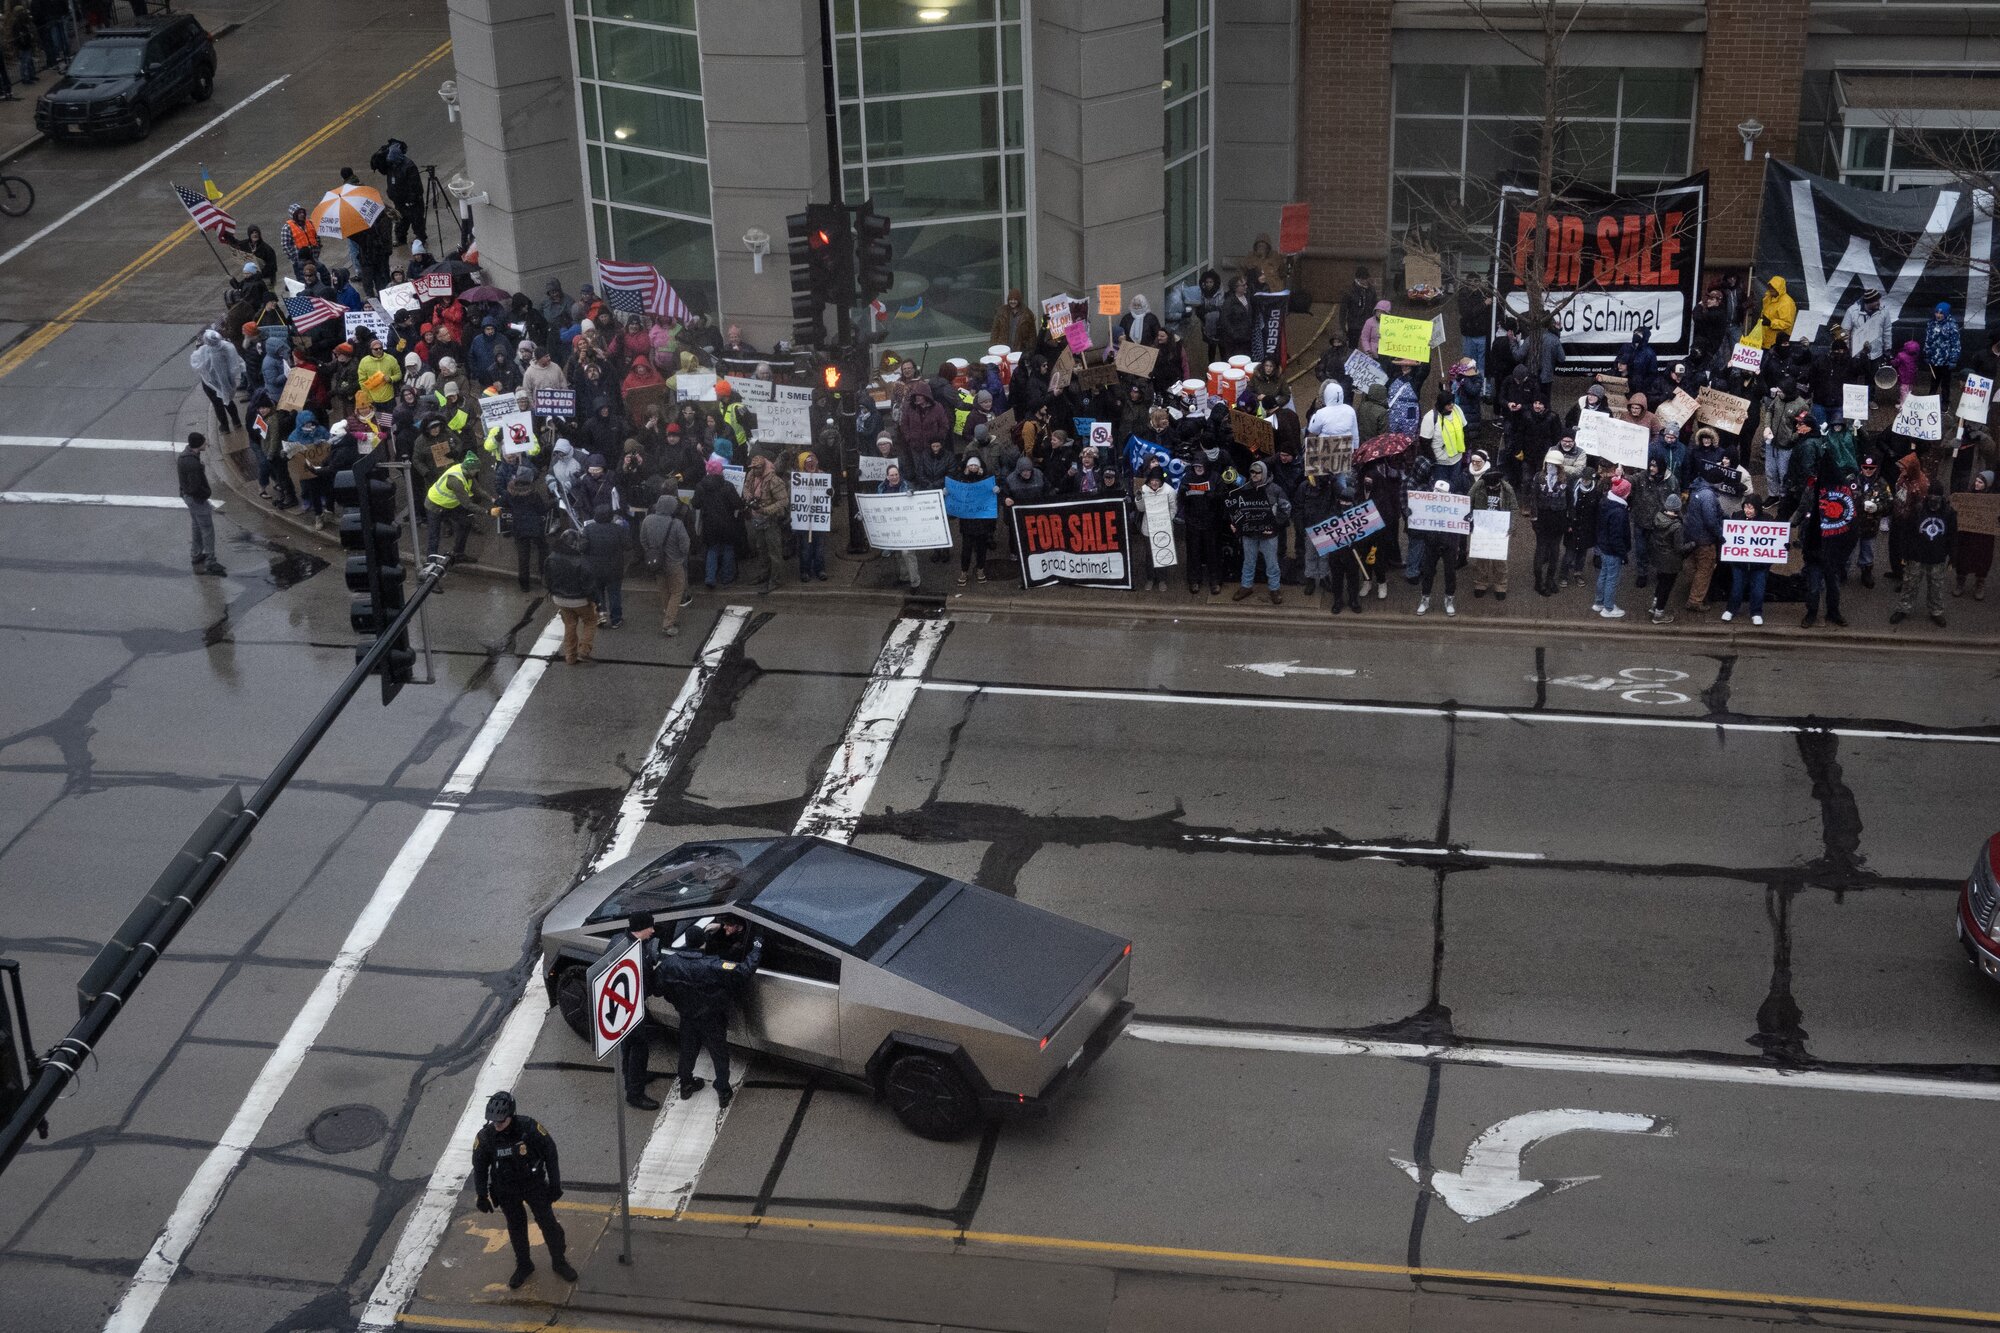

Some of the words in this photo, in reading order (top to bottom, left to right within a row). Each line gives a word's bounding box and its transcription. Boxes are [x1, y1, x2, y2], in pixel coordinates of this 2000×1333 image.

[1514, 212, 1584, 286] FOR
[1593, 211, 1684, 286] SALE
[1583, 298, 1660, 332] Schimel
[1701, 388, 1742, 406] Wisconsin
[767, 406, 803, 414] DEPORT
[1901, 417, 1924, 427] NOT
[762, 429, 774, 437] TO
[1896, 425, 1914, 436] FOR
[1914, 428, 1938, 439] SALE
[1307, 438, 1352, 453] NAZI
[792, 473, 828, 486] SHAME
[812, 496, 830, 504] NOT
[1408, 492, 1437, 500] POWER
[1440, 494, 1451, 502] TO
[1454, 496, 1469, 504] THE
[1425, 505, 1459, 515] PEOPLE
[1313, 504, 1370, 536] PROTECT
[1408, 518, 1426, 526] NOT
[1430, 519, 1446, 527] THE
[1447, 521, 1469, 530] ELITE
[1024, 514, 1065, 552] FOR
[1068, 511, 1119, 552] SALE
[1326, 515, 1369, 539] TRANS
[1726, 524, 1748, 533] MY
[1751, 526, 1787, 536] VOTE
[1334, 527, 1366, 547] KIDS
[1734, 536, 1745, 545] IS
[1750, 537, 1776, 546] NOT
[1724, 547, 1749, 556] FOR
[1753, 548, 1787, 558] SALE
[1041, 555, 1066, 573] Brad
[1069, 556, 1112, 573] Schimel
